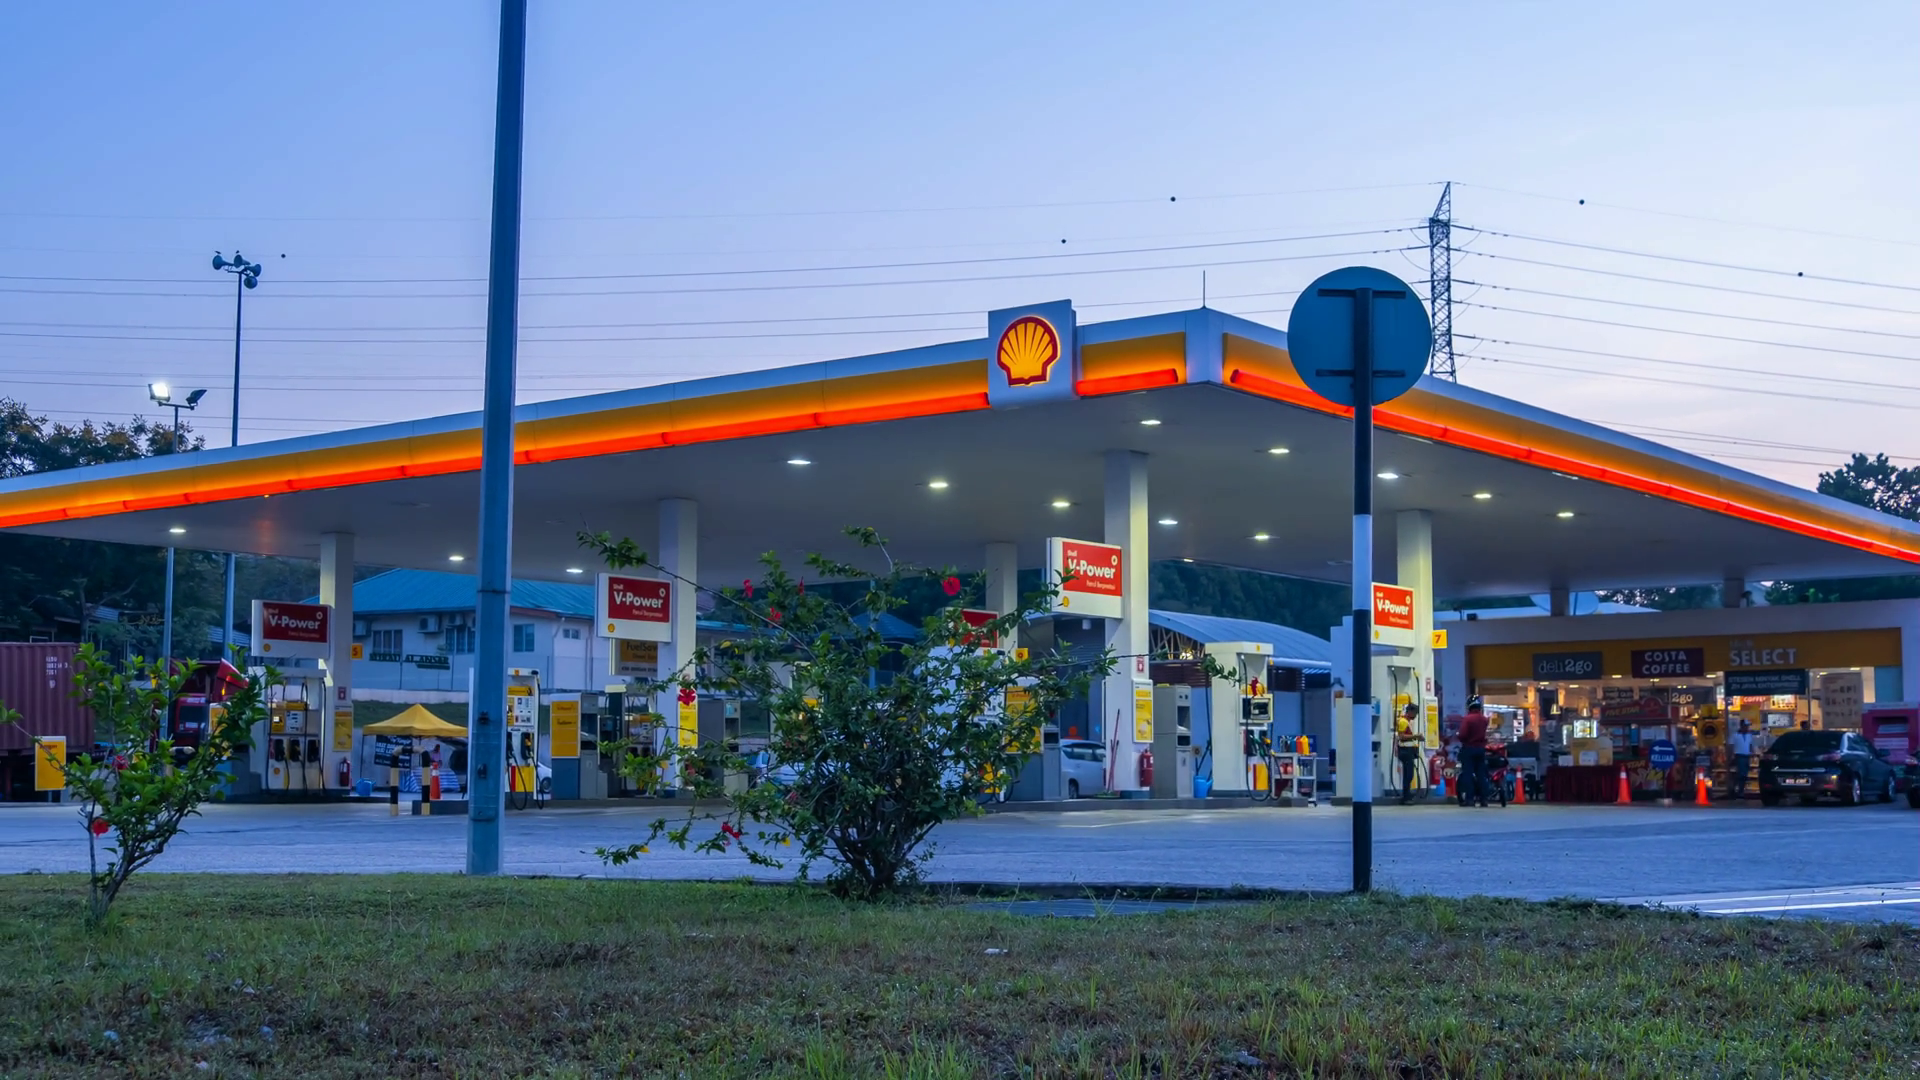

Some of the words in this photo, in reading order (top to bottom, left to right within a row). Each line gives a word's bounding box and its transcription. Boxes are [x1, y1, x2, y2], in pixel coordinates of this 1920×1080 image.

[1067, 558, 1116, 579] V-Power
[613, 591, 664, 608] V-Power
[1376, 598, 1410, 616] V-Power
[268, 615, 321, 630] V-Power
[626, 641, 658, 652] FuelSav
[1434, 634, 1442, 645] 7
[1644, 650, 1687, 662] COSTA
[1729, 648, 1797, 667] SELECT
[1538, 658, 1593, 675] deli2go
[1642, 663, 1690, 675] COFFEE
[1651, 754, 1675, 762] KELUAR
